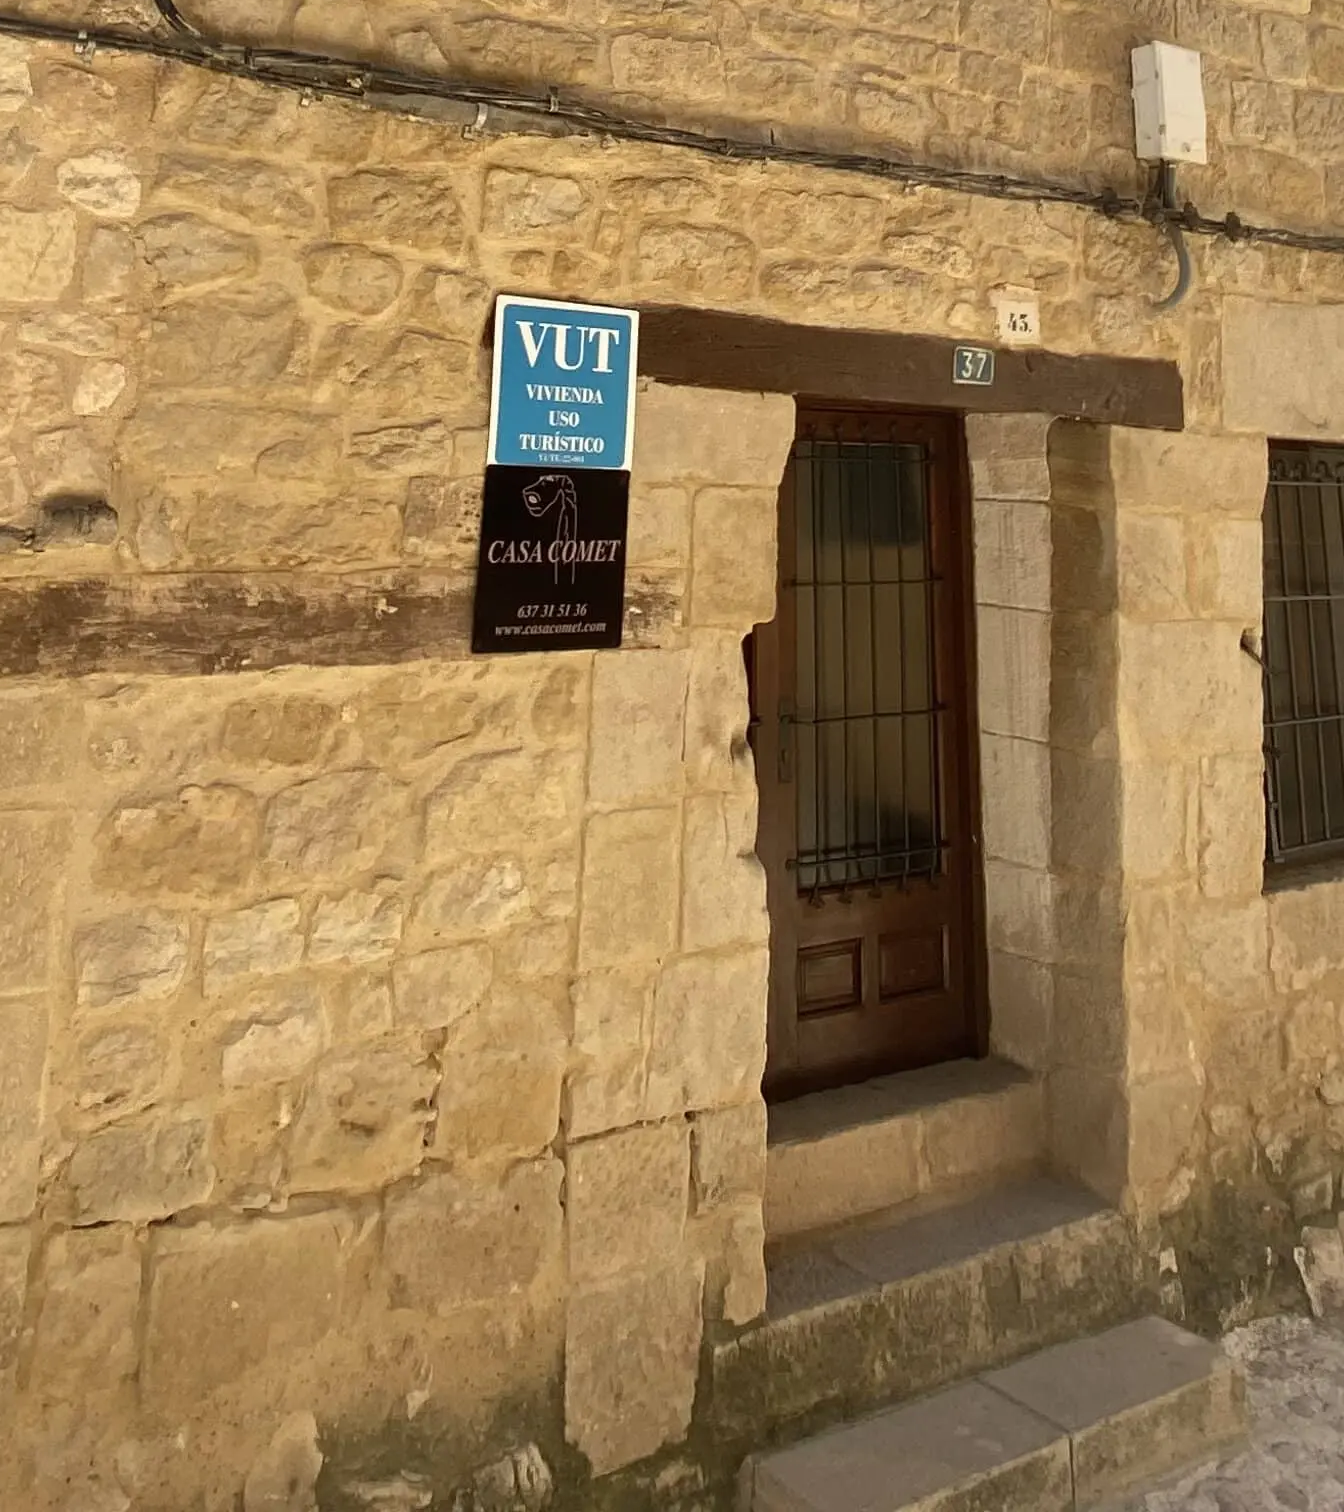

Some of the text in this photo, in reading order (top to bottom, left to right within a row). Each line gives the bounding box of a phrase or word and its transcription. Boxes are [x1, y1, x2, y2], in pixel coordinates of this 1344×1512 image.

[515, 320, 620, 374] VUT
[961, 351, 987, 379] 37
[526, 383, 604, 405] VIVIENDA
[548, 409, 581, 428] USO
[519, 431, 605, 454] TURÍSTICO
[488, 539, 621, 564] CASA COMET
[516, 603, 587, 618] 637 31 51 36
[495, 621, 607, 636] www.casacomet.com
